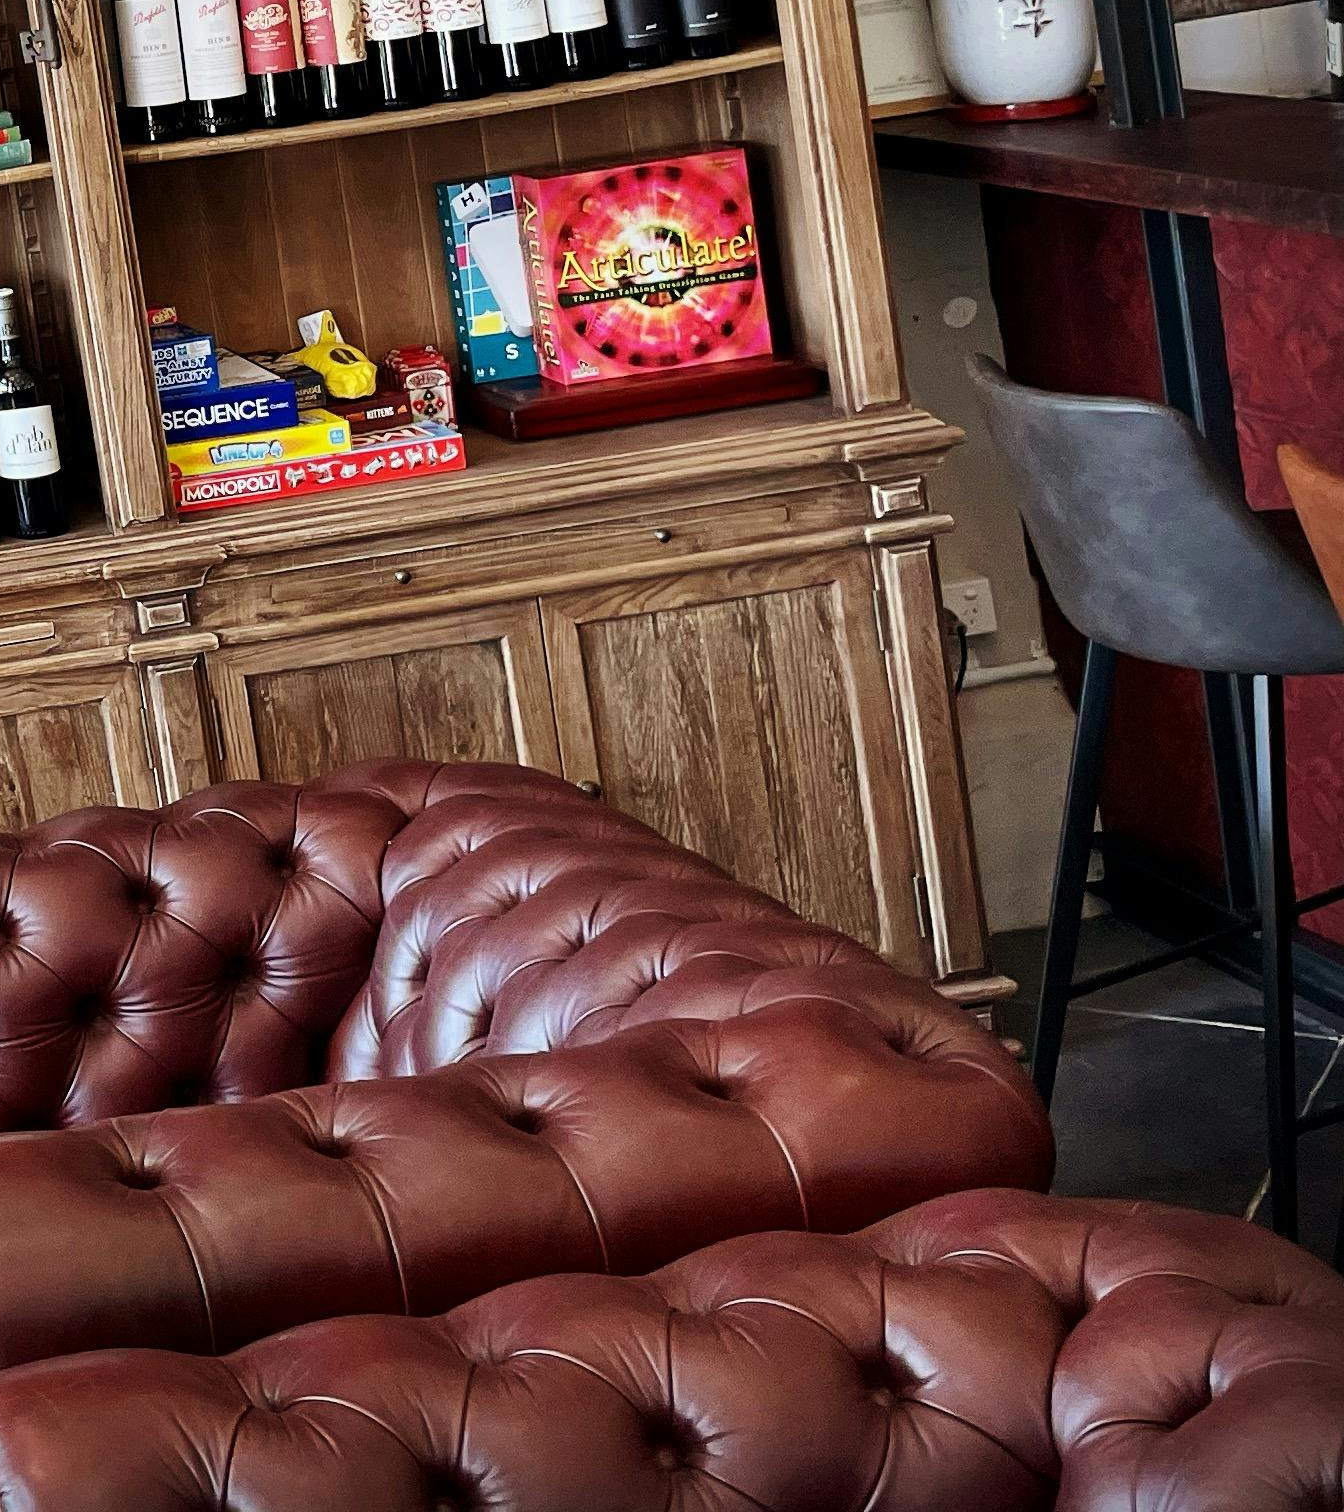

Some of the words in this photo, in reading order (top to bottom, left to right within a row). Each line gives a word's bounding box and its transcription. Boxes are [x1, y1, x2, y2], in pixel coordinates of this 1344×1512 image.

[133, 5, 167, 26] Penfolds
[461, 191, 475, 207] H
[558, 225, 757, 292] Articulate!
[522, 194, 561, 367] Articulate!
[572, 295, 590, 303] The
[594, 292, 614, 300] Fast
[618, 286, 656, 297] Talking
[658, 276, 716, 290] Description
[719, 271, 745, 280] Game
[161, 398, 270, 431] SEQUENCE
[210, 443, 247, 465] LINE
[248, 441, 270, 461] UP
[269, 439, 284, 459] 4
[186, 474, 276, 501] MONOPOLY
